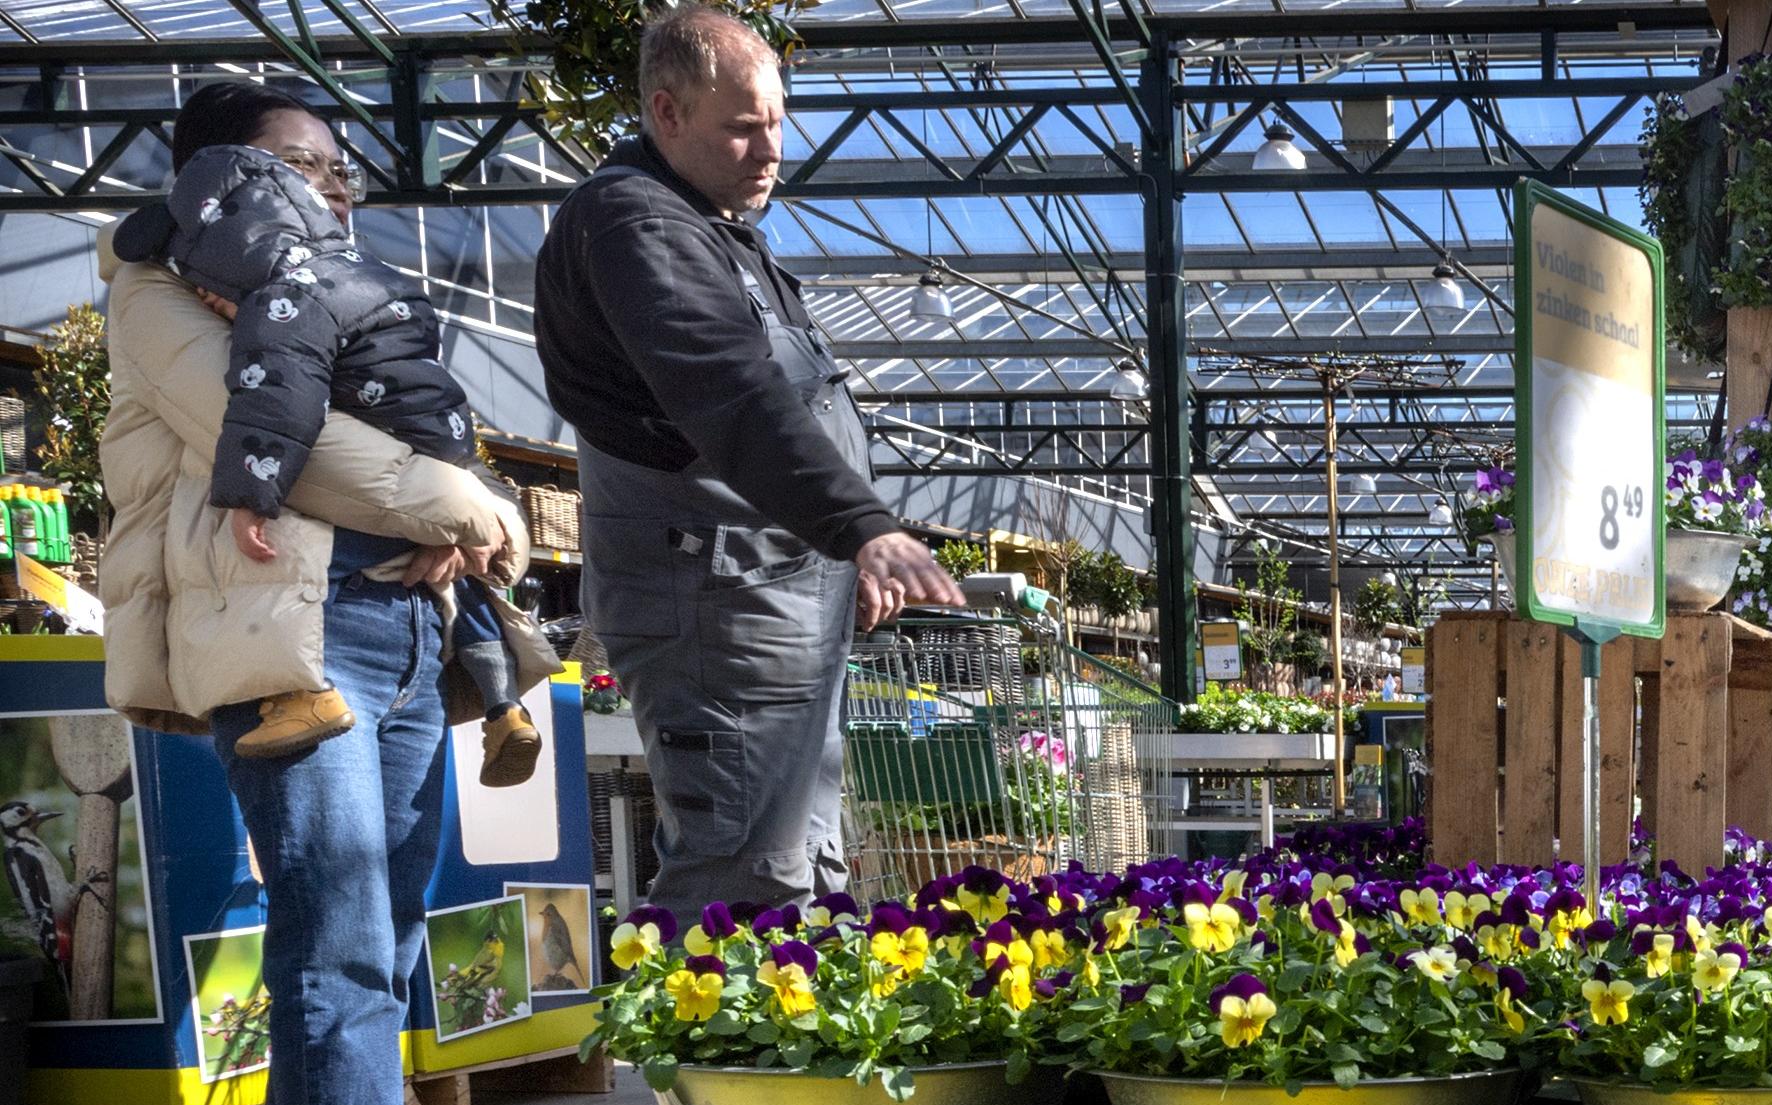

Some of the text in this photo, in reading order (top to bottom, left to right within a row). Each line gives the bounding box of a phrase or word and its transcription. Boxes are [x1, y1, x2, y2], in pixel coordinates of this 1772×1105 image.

[1536, 240, 1605, 293] Violen in
[1536, 288, 1640, 349] zinken schaal
